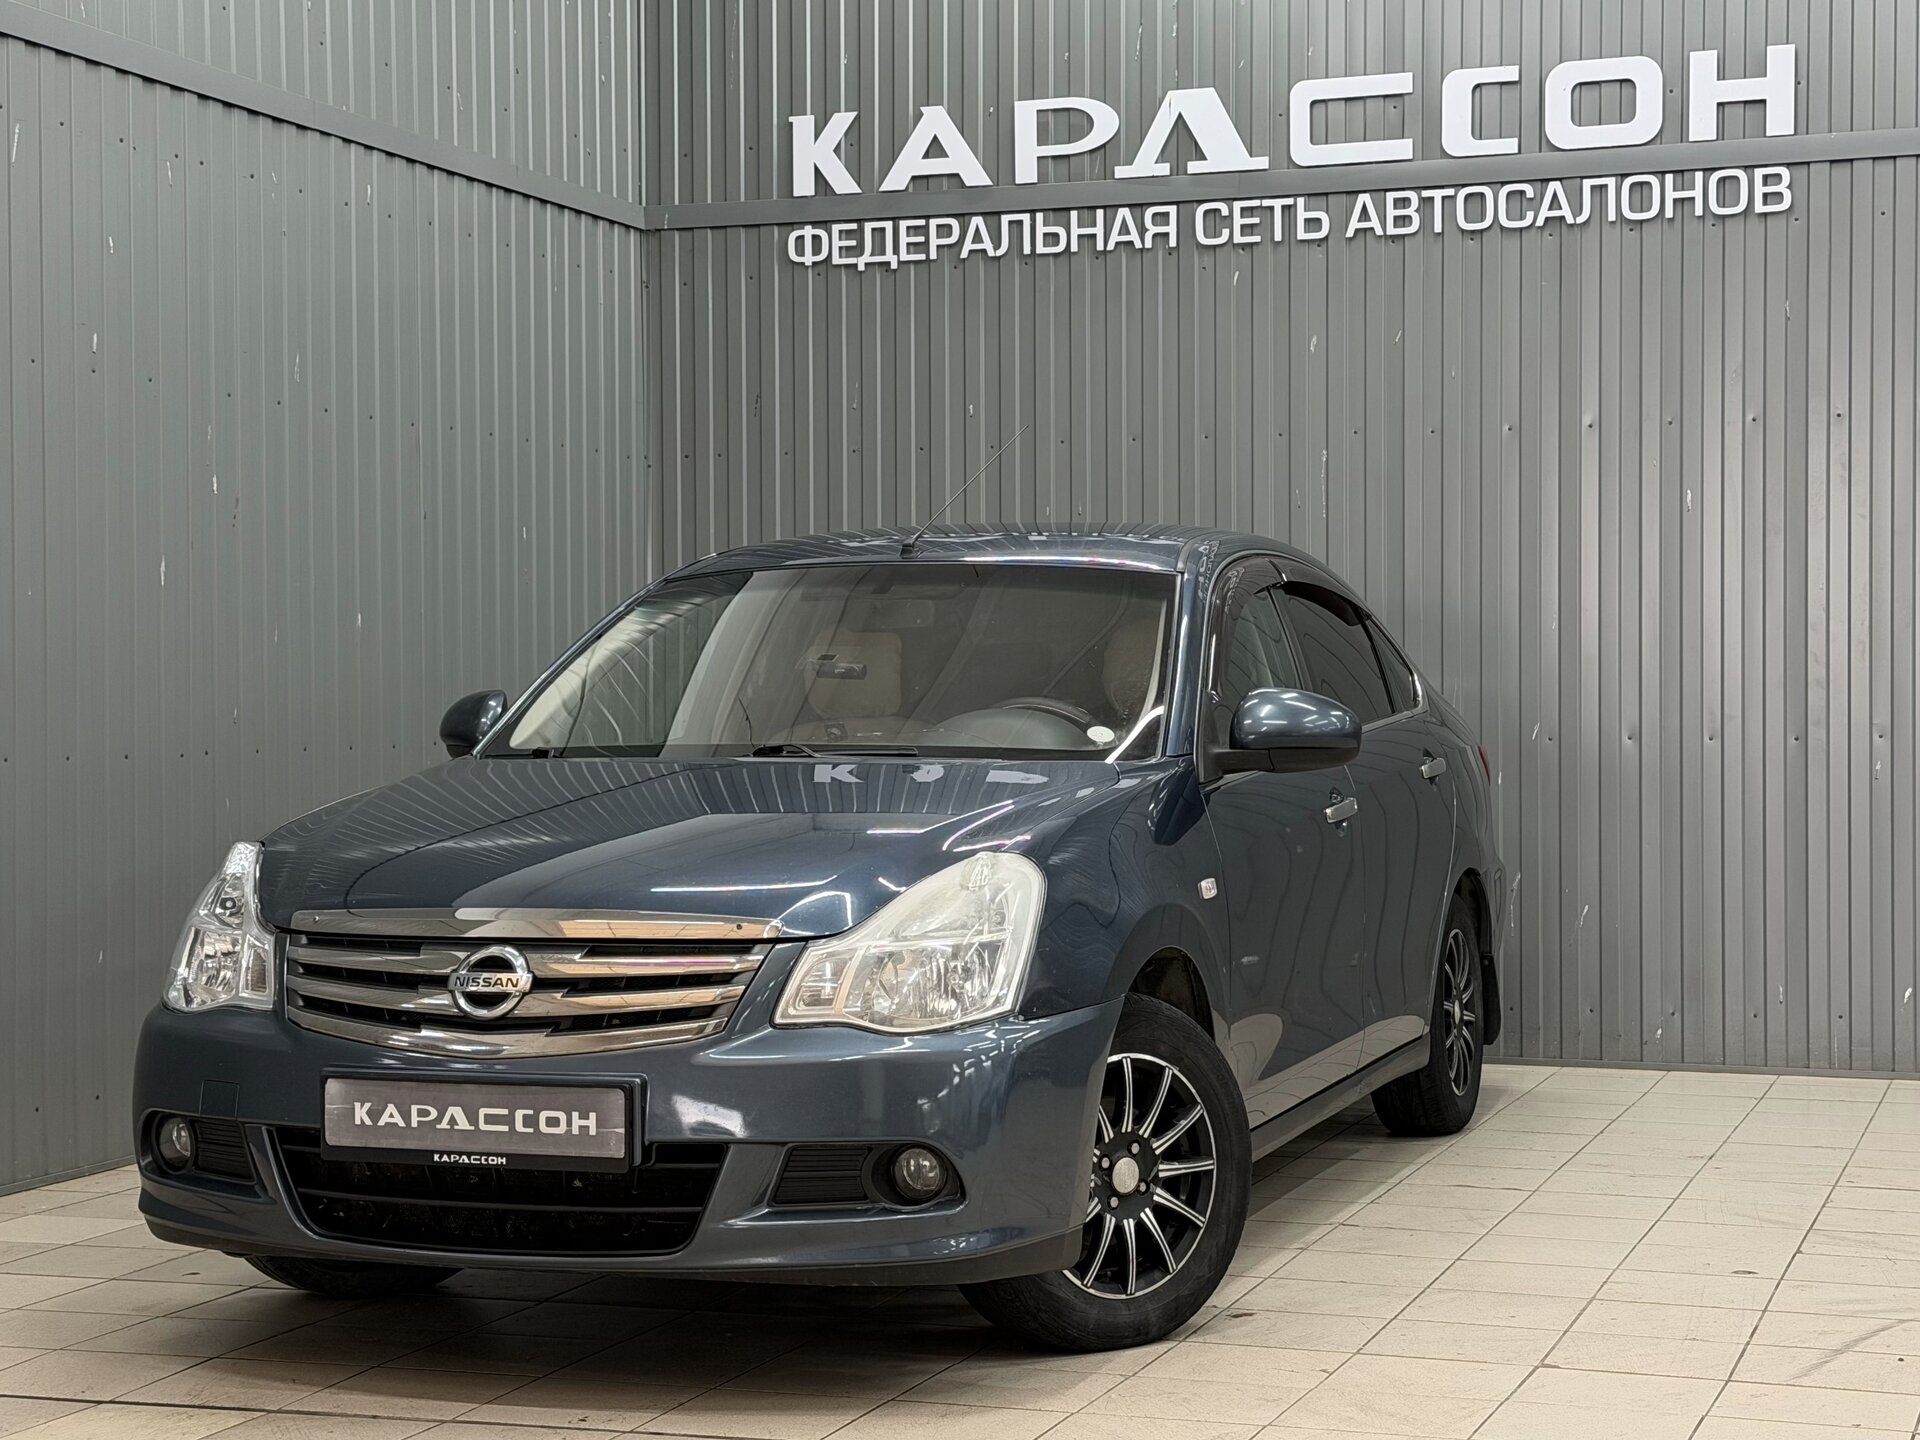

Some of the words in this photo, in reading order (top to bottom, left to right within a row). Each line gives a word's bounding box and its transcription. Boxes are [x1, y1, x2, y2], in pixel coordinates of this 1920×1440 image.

[787, 205, 1178, 271] ФЕДЕРАЛЬНАЯ
[1195, 195, 1331, 246] СЕТЬ
[1345, 166, 1793, 238] АВТОСАЛОНОВ
[454, 976, 519, 989] NISSAN
